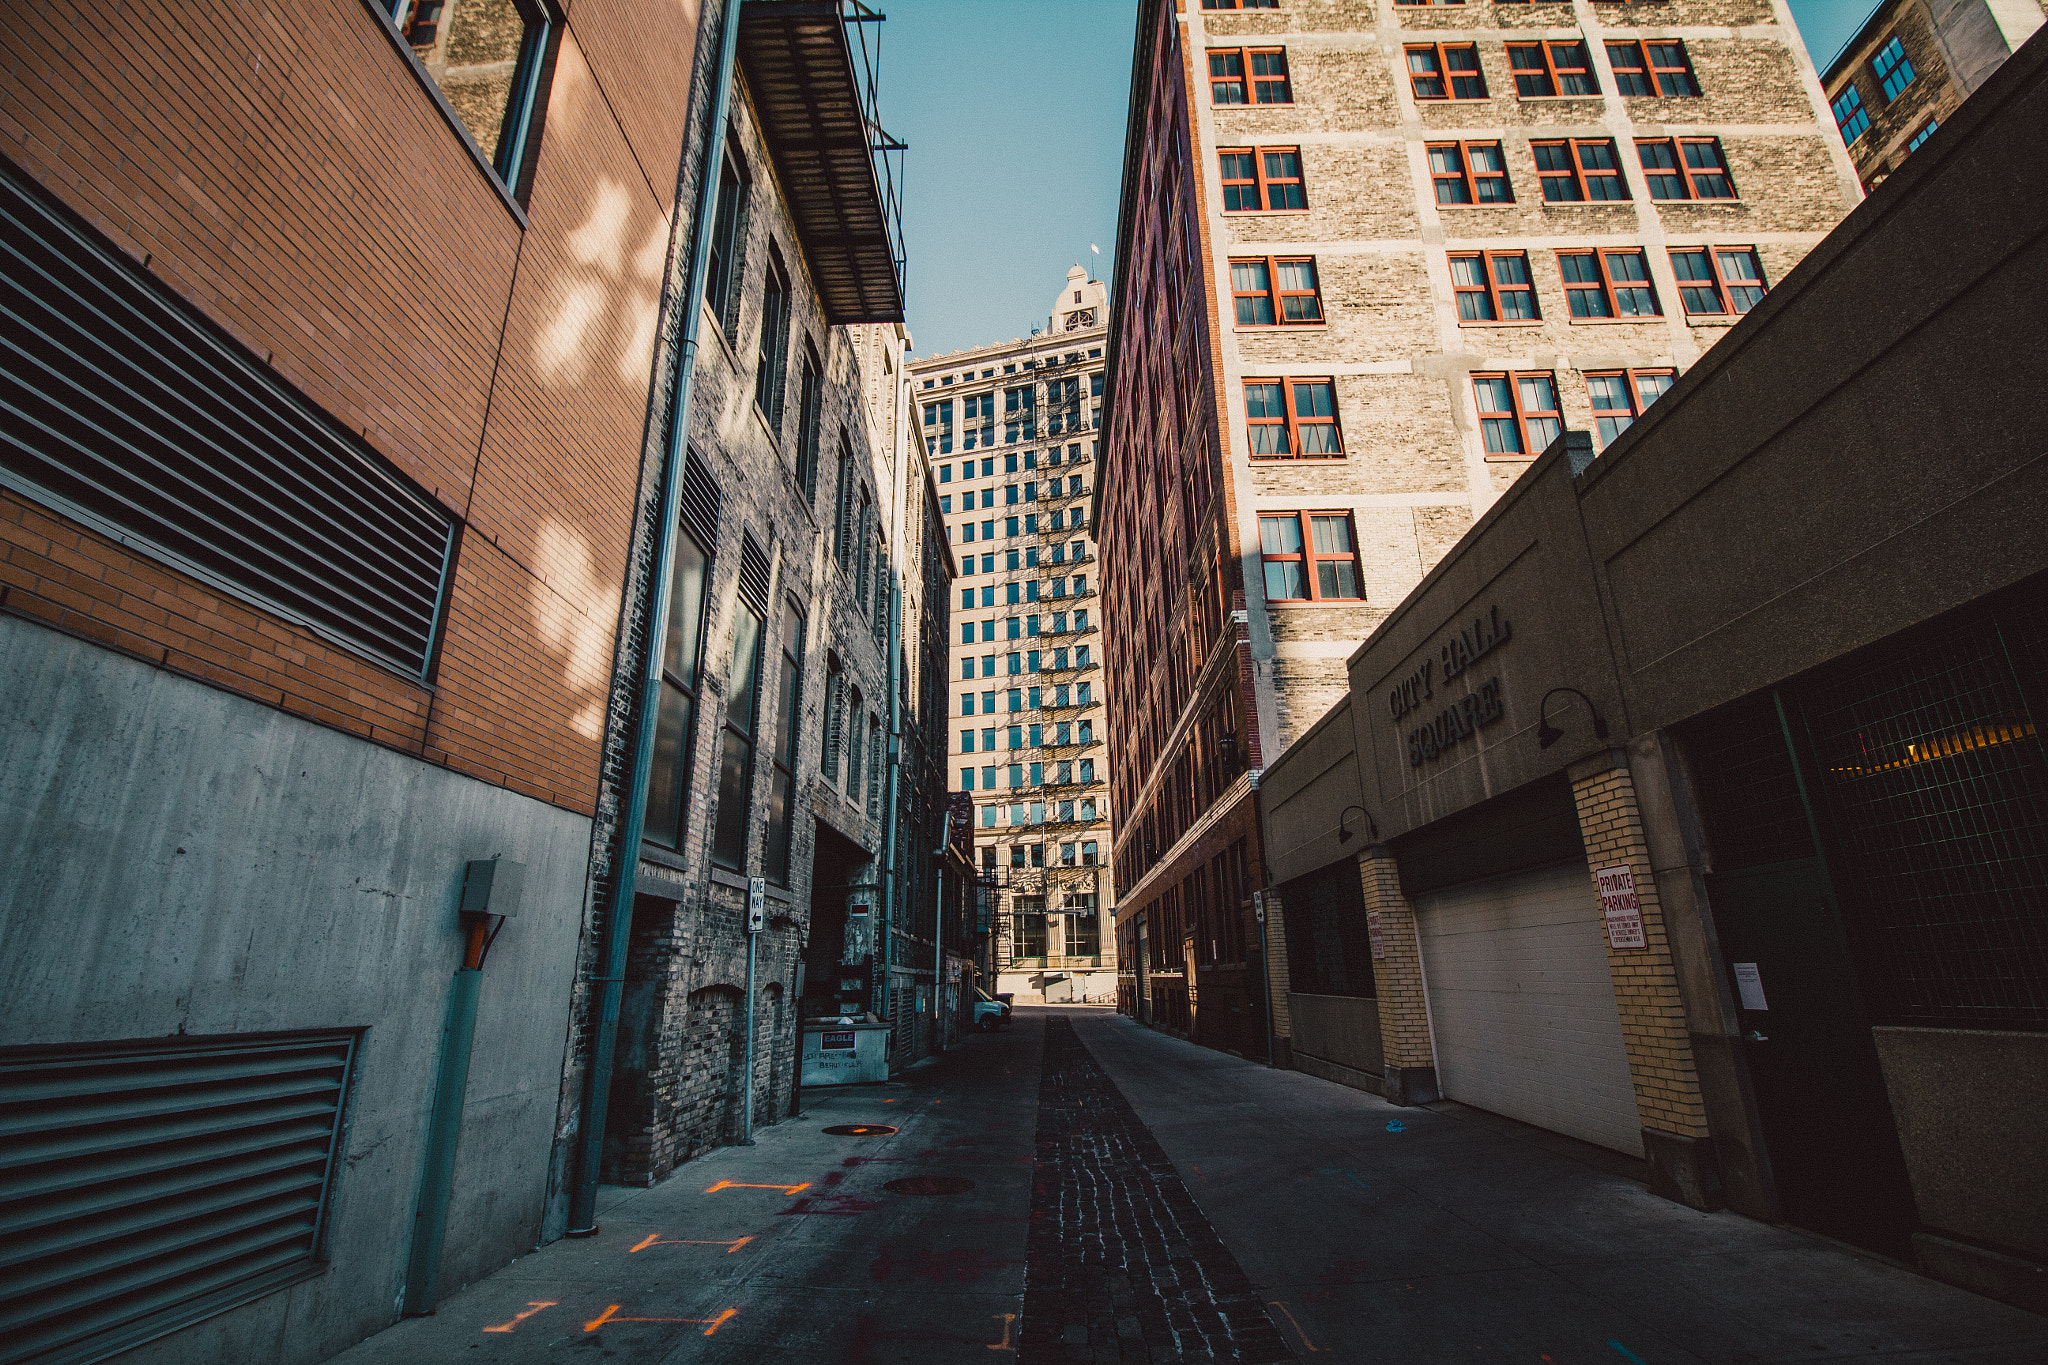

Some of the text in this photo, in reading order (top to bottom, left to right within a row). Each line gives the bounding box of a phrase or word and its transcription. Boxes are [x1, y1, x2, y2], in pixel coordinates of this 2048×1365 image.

[1390, 605, 1512, 722] CITY HALL
[1408, 676, 1503, 767] SQUARE
[752, 881, 763, 893] ONE
[1599, 873, 1632, 892] PRIVATE
[752, 895, 763, 909] WAY
[1603, 893, 1637, 912] PARKING
[824, 1034, 853, 1042] EAGLE
